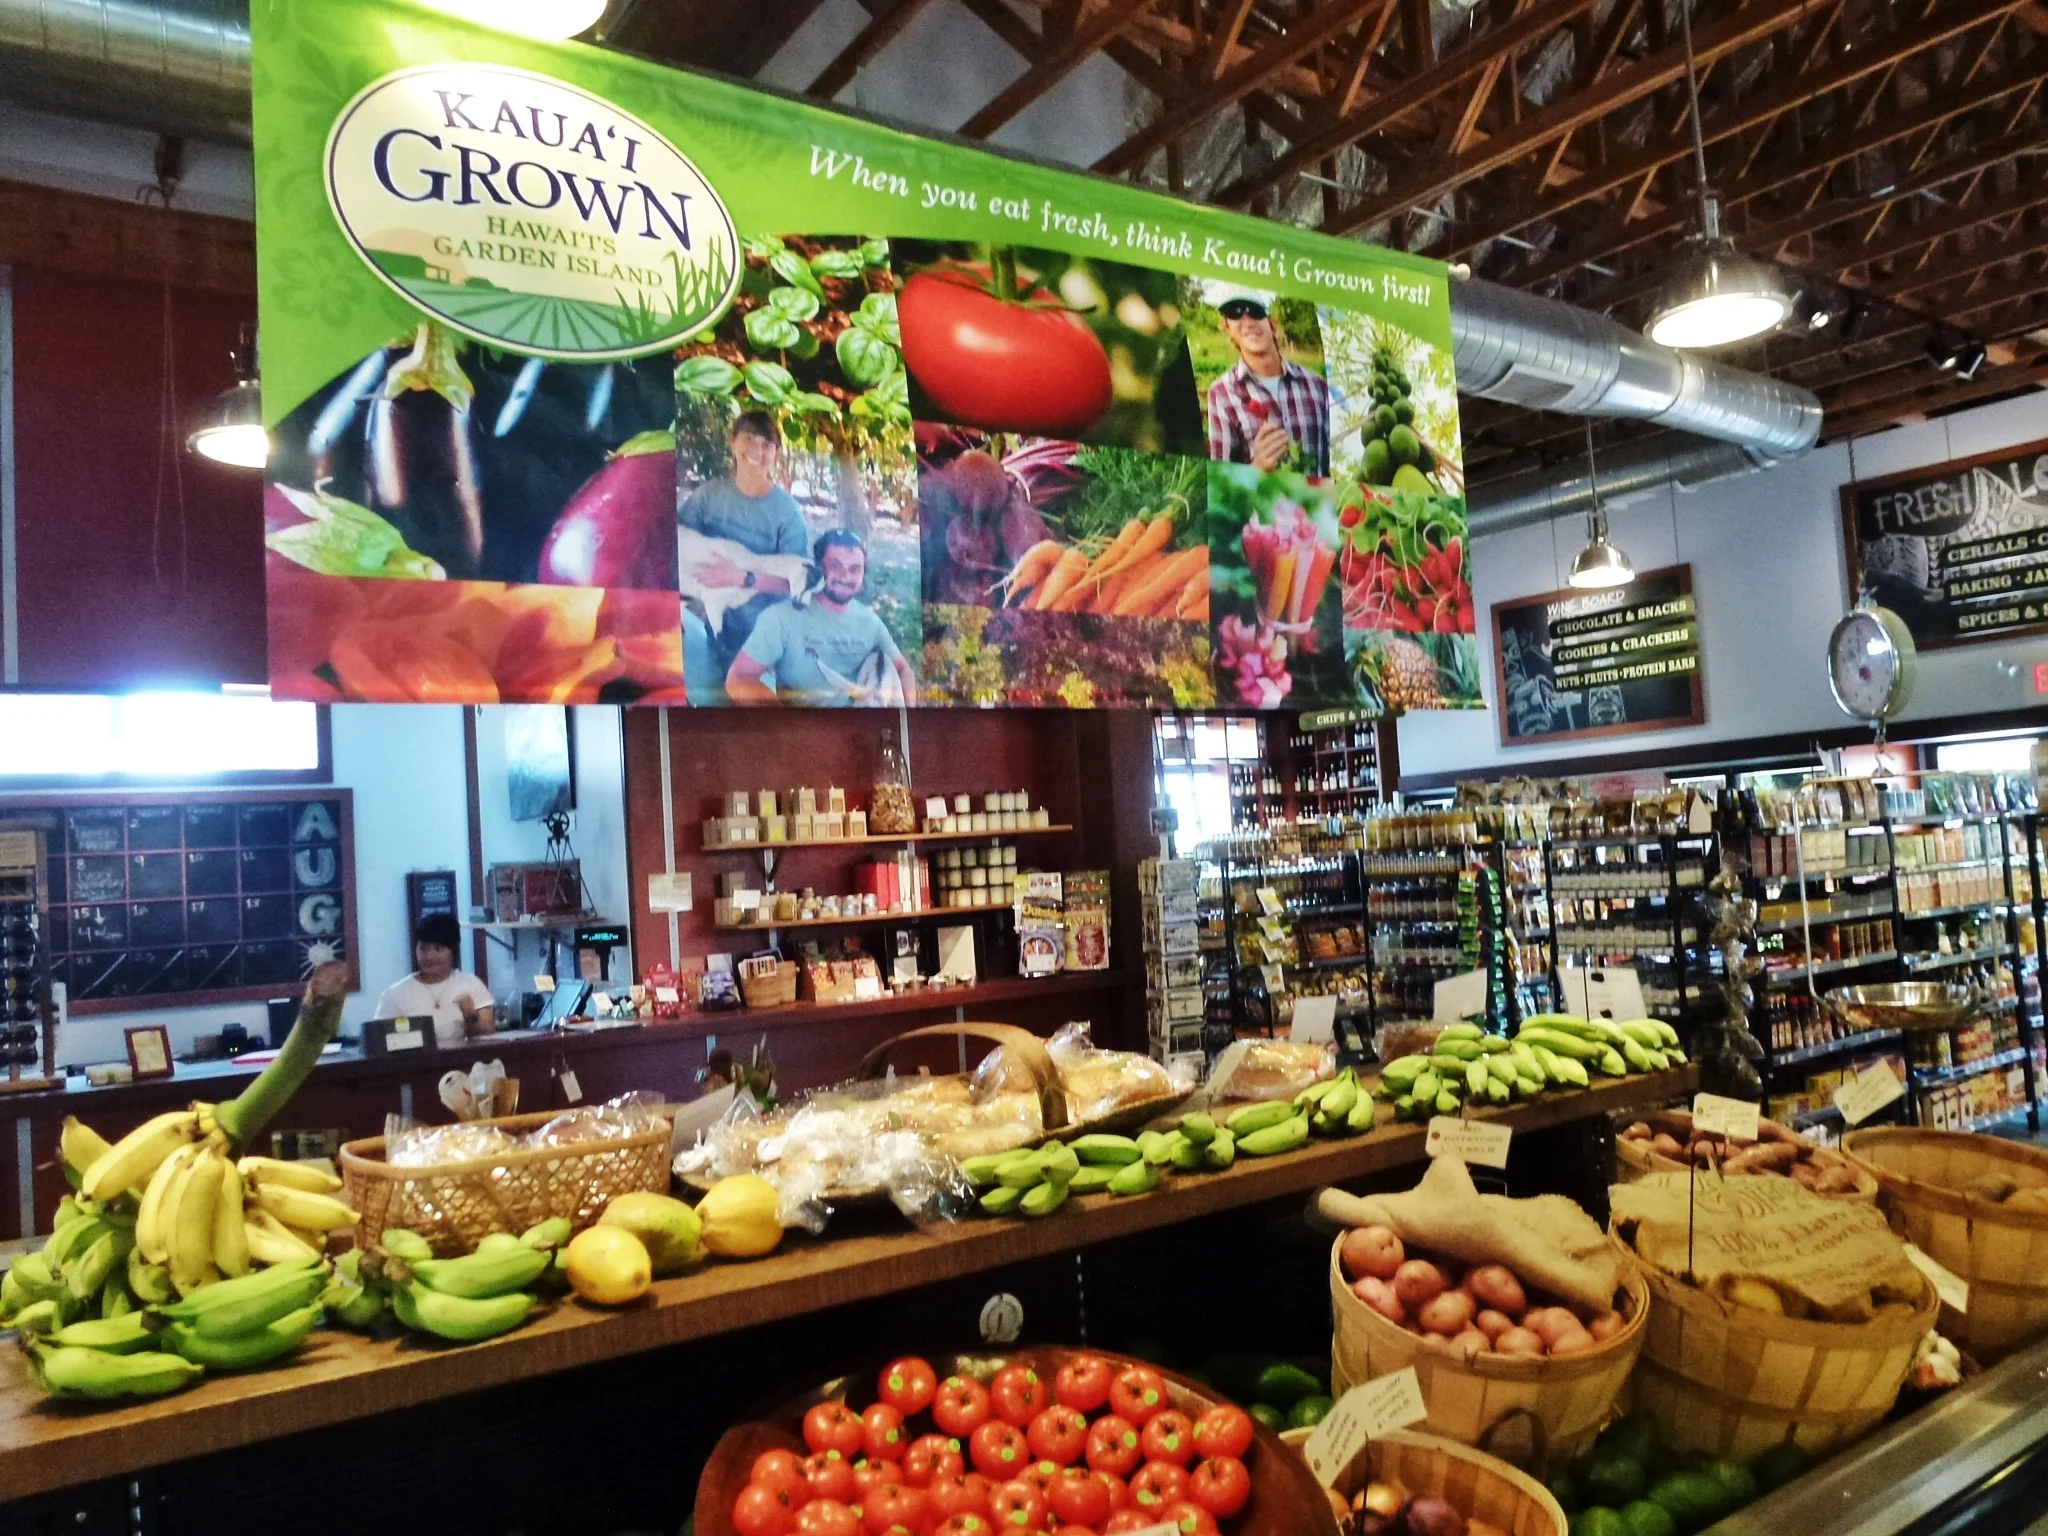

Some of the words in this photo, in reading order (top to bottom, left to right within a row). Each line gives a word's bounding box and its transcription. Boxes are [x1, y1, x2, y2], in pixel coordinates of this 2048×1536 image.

[373, 128, 693, 252] GROWN
[807, 145, 909, 198] When
[921, 181, 978, 210] you
[988, 196, 1031, 222] eat
[1039, 200, 1119, 249] fresh,
[1124, 221, 1194, 262] think
[1294, 258, 1375, 296] Grown
[1381, 270, 1432, 308] first!
[433, 236, 557, 270] GARDEN
[566, 256, 664, 287] ISLAND
[1872, 472, 1975, 532] FRESH
[1947, 536, 2028, 563] CEREALS
[1950, 574, 2013, 597] BAKING
[2024, 566, 2048, 585] JA
[1581, 589, 1626, 609] BOARD
[1556, 612, 1623, 635] CHOCOLATE
[1625, 610, 1635, 622] &
[1637, 599, 1688, 621] SNACKS
[1958, 607, 2020, 630] SPICES
[2024, 605, 2039, 620] &
[1557, 643, 1608, 661] COOKIES
[1610, 640, 1620, 653] &
[1622, 628, 1690, 650] CRACKERS
[1668, 656, 1696, 672] BARS
[1316, 711, 1345, 725] CHIPS
[1348, 710, 1357, 721] &
[73, 906, 90, 920] 15
